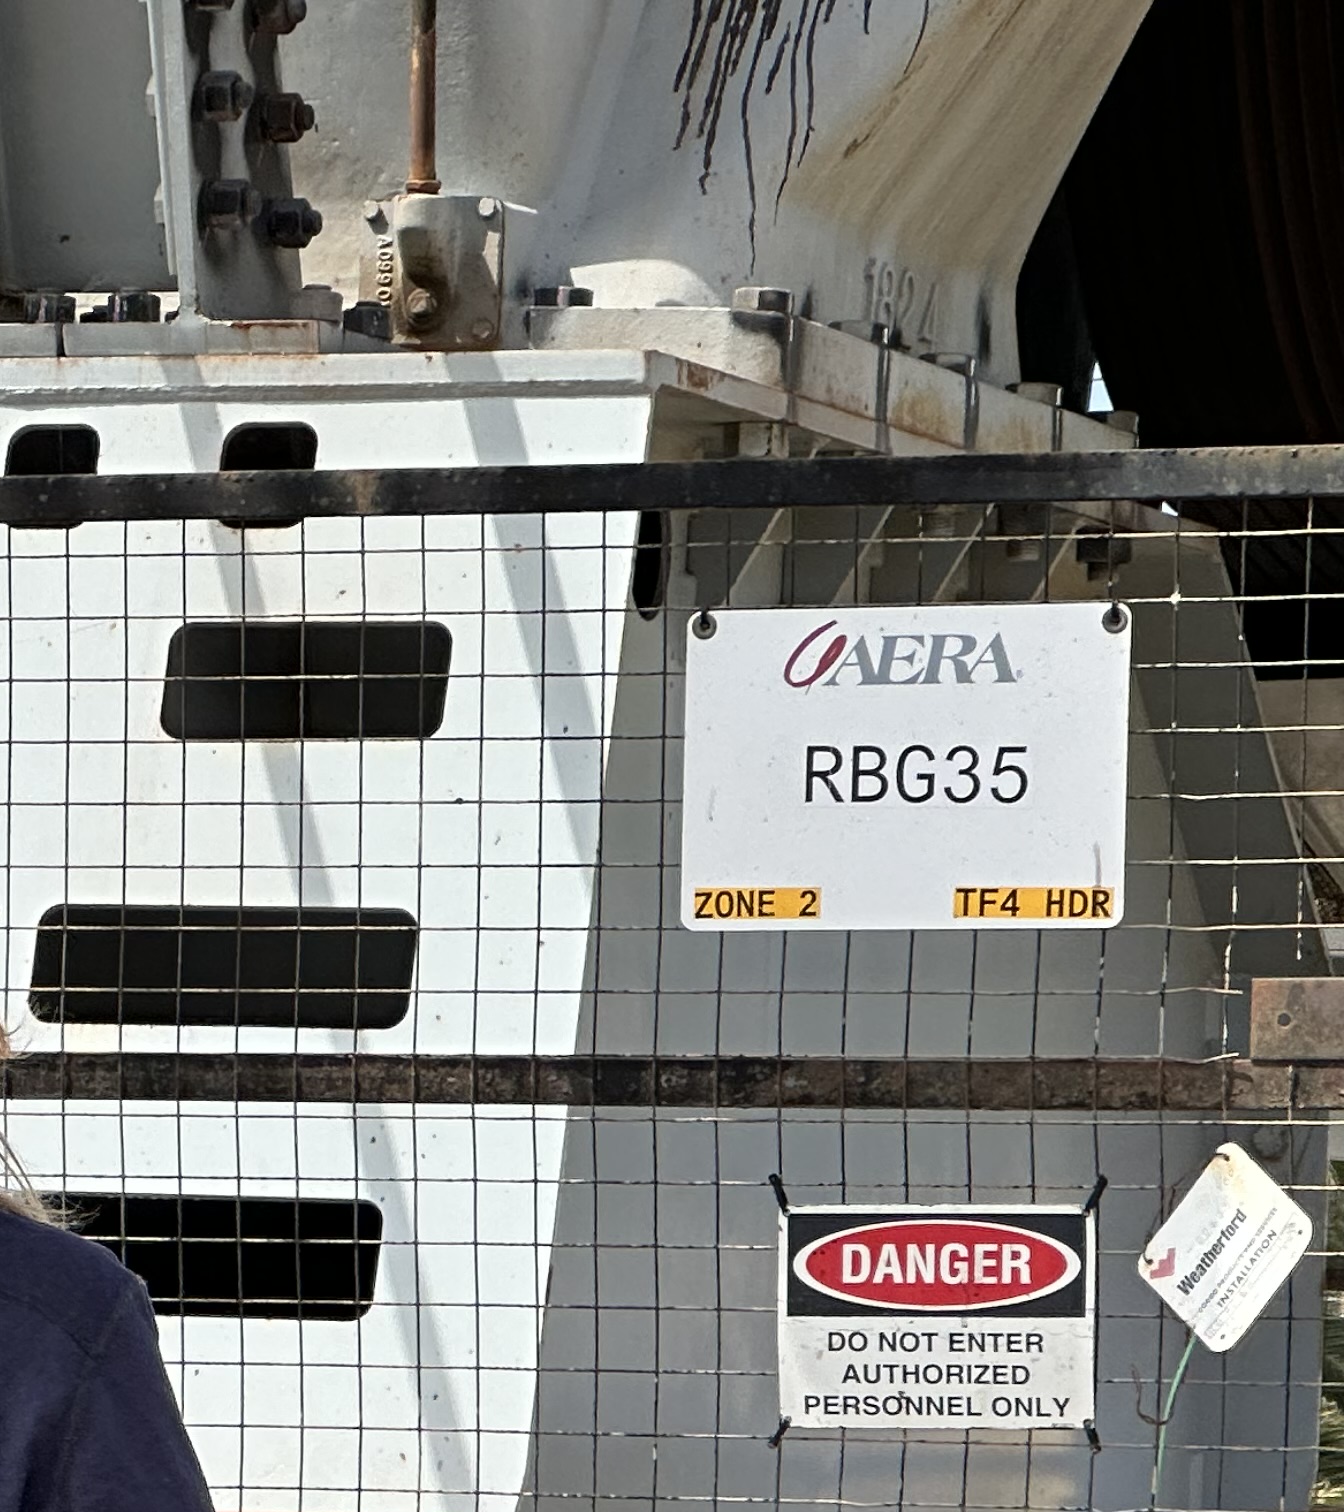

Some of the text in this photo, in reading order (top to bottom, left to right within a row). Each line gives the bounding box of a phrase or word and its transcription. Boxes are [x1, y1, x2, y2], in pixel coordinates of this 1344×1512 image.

[823, 632, 1017, 686] AERA
[804, 745, 1029, 804] RBG35
[694, 889, 818, 919] ZONE 2
[956, 888, 1112, 918] TF4 HDR
[842, 1243, 1032, 1285] DANGER
[1175, 1207, 1248, 1296] Weatherford
[1215, 1229, 1278, 1308] INSTALLATION
[828, 1332, 1044, 1353] DO NOT ENTER
[842, 1364, 1031, 1385] AUTHORIZED
[804, 1395, 1071, 1417] PERSONNEL ONLY
